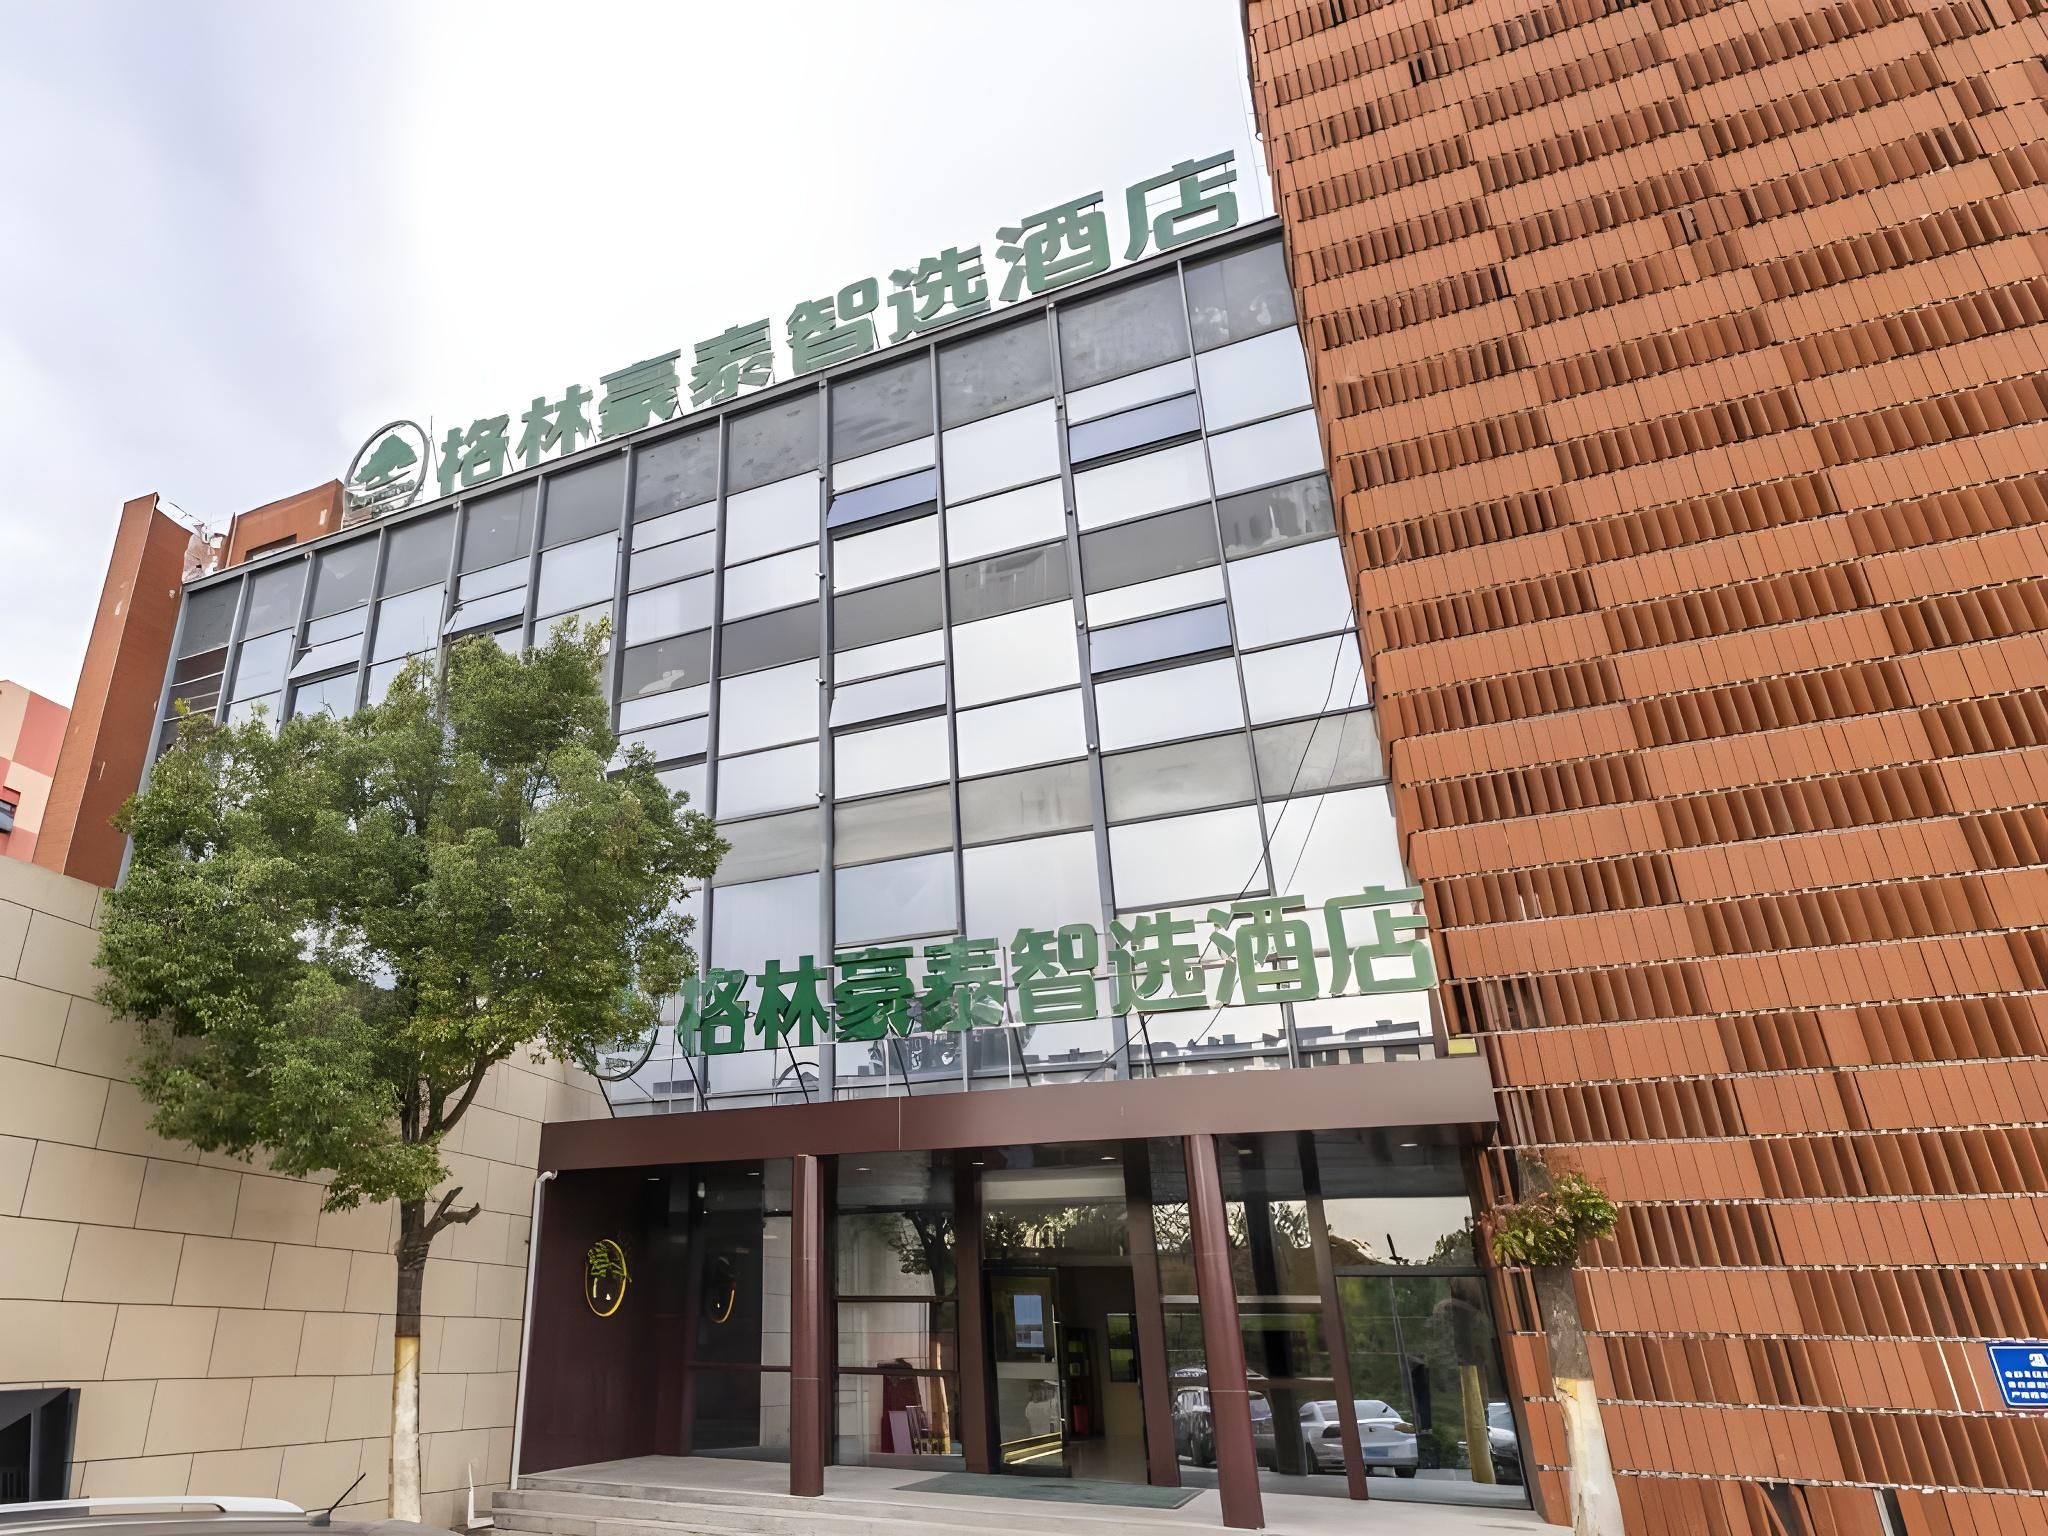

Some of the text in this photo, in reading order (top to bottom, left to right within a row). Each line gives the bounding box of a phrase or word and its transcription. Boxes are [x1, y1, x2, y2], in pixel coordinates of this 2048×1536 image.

[437, 150, 1239, 497] 格林豪泰智选酒店
[677, 886, 1437, 1056] 格林豪泰智选酒店
